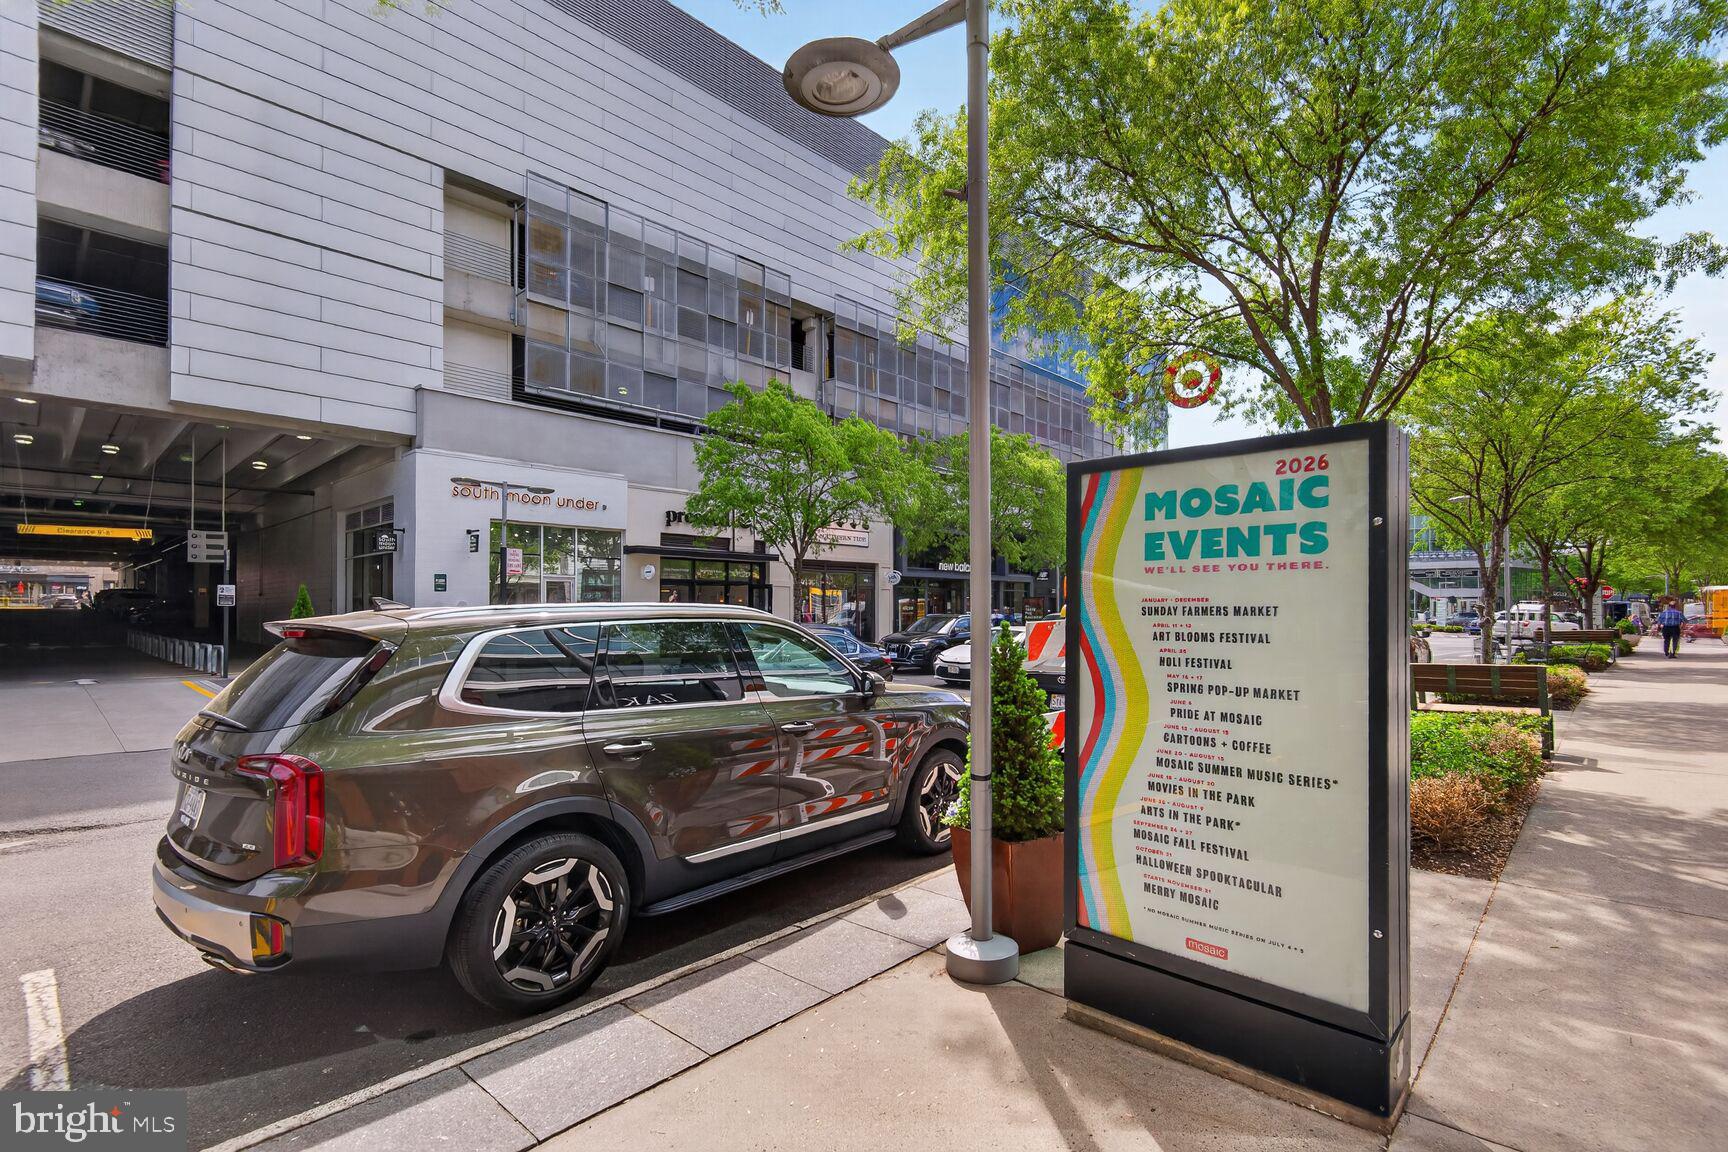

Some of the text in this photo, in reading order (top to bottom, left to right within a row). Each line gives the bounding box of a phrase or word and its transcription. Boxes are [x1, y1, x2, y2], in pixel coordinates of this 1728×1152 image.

[1276, 454, 1329, 475] 2026
[452, 485, 600, 510] south moon under
[1144, 475, 1329, 521] MOSAIC
[1144, 521, 1329, 561] EVENTS
[938, 562, 954, 570] new
[1144, 560, 1329, 574] WE'LL SEE YOU THERE.
[1141, 606, 1279, 617] SUNDAY FARMERS MARKET
[1152, 632, 1270, 644] ART BLOOMS FESTIVAL
[1160, 656, 1232, 669] HOLI FESTIVAL
[1167, 682, 1300, 701] SPRING POP-UP MARKET
[1170, 708, 1262, 726] PRIDE AT MOSAIC
[1163, 732, 1216, 748] CARTOONS
[1232, 740, 1271, 754] COFFEE
[1156, 757, 1194, 771] MOSAIC
[1198, 762, 1242, 778] SUMMER
[1247, 769, 1283, 783] MUSIC
[1147, 781, 1255, 807] MOVIES IN THE PARK
[1133, 820, 1168, 830] SEPTEMBER
[1140, 805, 1164, 818] ARTS
[1169, 810, 1179, 820] IN
[1183, 812, 1201, 825] THE
[1133, 829, 1249, 861] MOSAIC FALL FESTIVAL
[1136, 846, 1164, 855] OCTOBER
[1136, 854, 1282, 898] HALLOWEEN SPOOKTACULAR
[1144, 874, 1165, 882] STARTS
[1167, 879, 1202, 892] NOVEMBER
[1144, 882, 1219, 911] MERRY MOSAIC
[1157, 910, 1180, 920] MOSAIC
[1182, 916, 1206, 927] SUMMER
[1209, 924, 1229, 934] MUSIC
[1231, 930, 1253, 940] SERIES
[1268, 940, 1285, 948] JULY
[1188, 939, 1225, 957] mosaic
